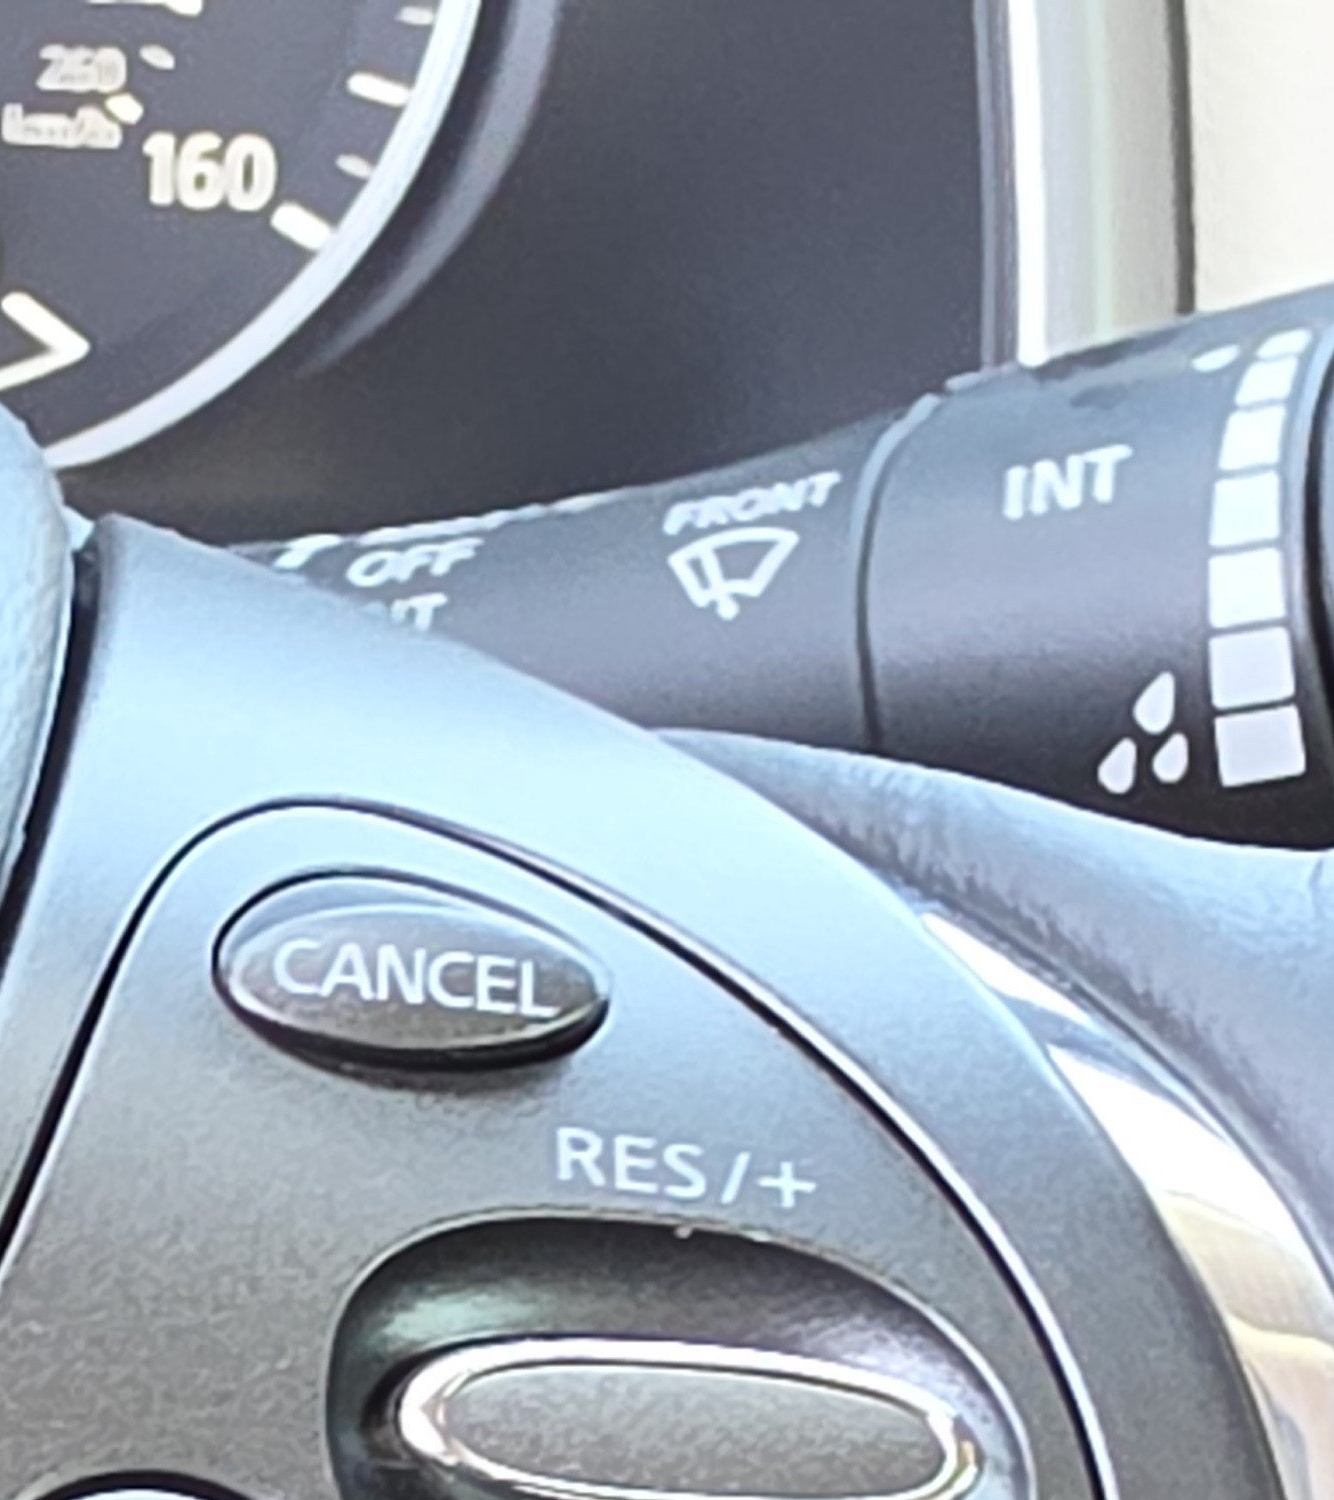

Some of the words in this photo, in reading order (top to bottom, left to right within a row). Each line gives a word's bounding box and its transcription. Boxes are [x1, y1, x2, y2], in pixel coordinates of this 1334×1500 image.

[142, 131, 278, 212] 160
[663, 470, 841, 536] FRONT
[1000, 442, 1134, 520] INT
[345, 537, 485, 588] OFF
[271, 937, 562, 1020] CANCEL
